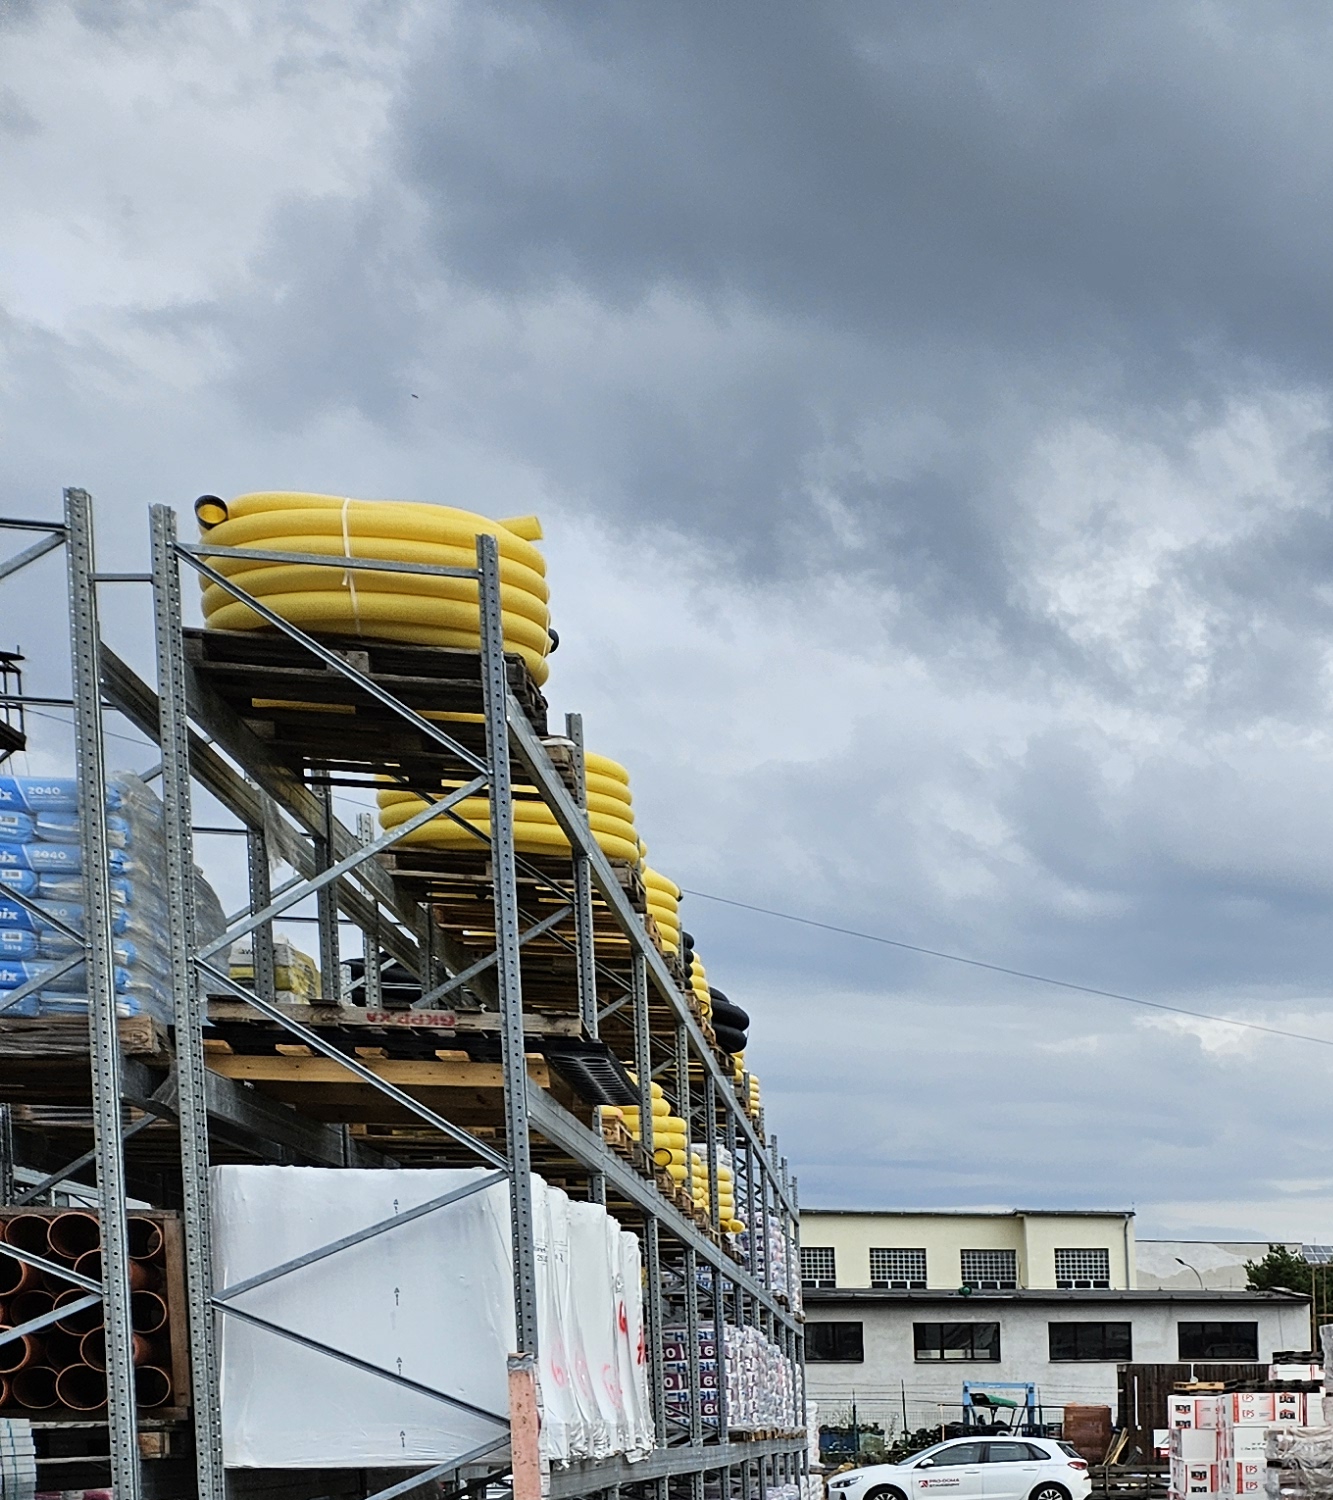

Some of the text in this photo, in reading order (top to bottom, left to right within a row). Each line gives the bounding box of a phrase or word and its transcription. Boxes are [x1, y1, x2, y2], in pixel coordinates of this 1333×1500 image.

[1242, 1394, 1254, 1402] EPS
[1242, 1409, 1255, 1418] EPS
[1246, 1465, 1258, 1475] EPS
[1246, 1481, 1258, 1490] EPS
